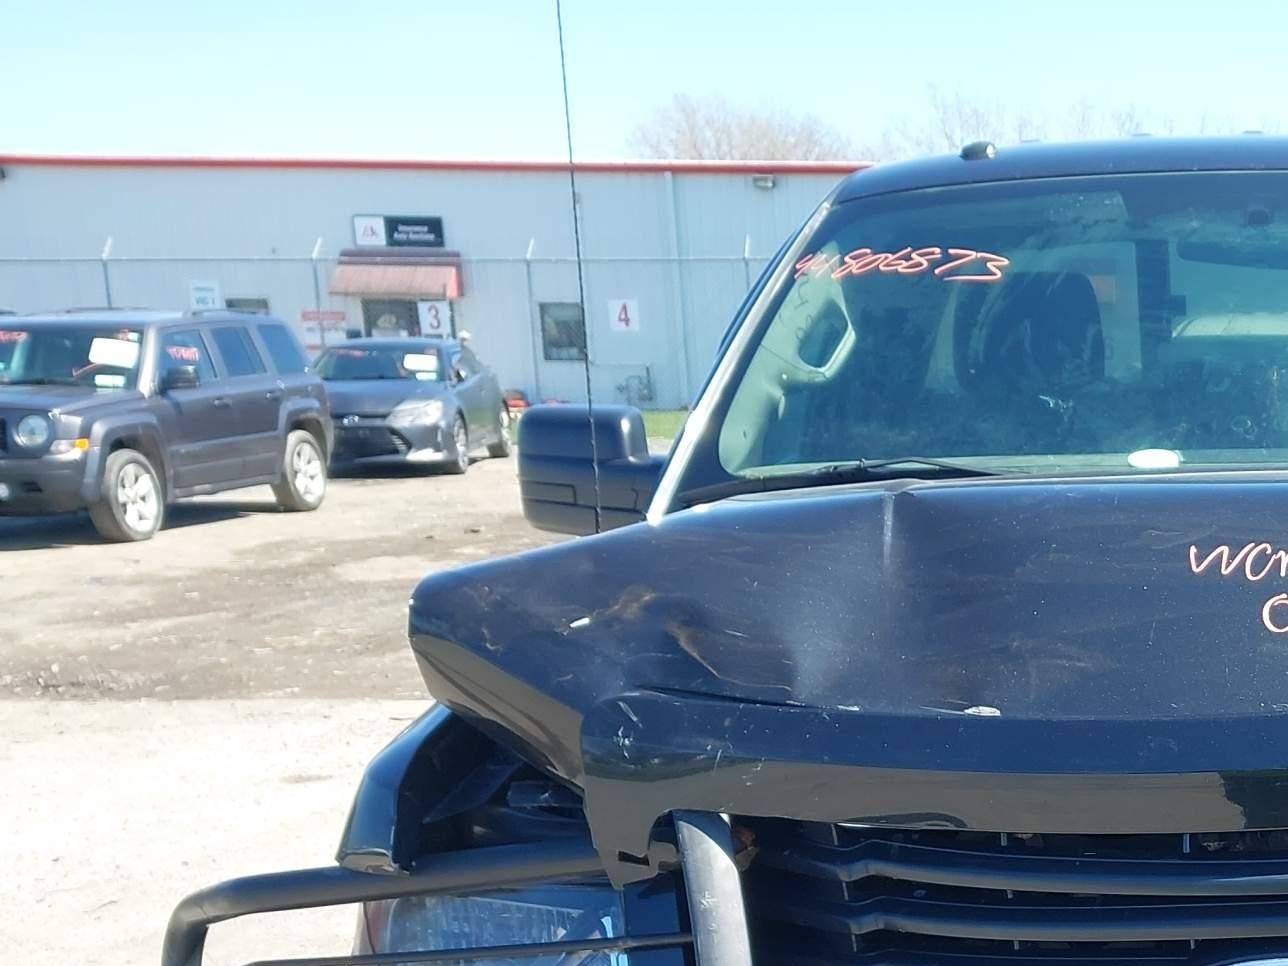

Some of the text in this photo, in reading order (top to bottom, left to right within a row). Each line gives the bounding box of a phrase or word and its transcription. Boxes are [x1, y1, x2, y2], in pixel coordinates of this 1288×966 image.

[794, 247, 1010, 281] 44806873
[427, 304, 441, 330] 3
[617, 303, 631, 328] 4
